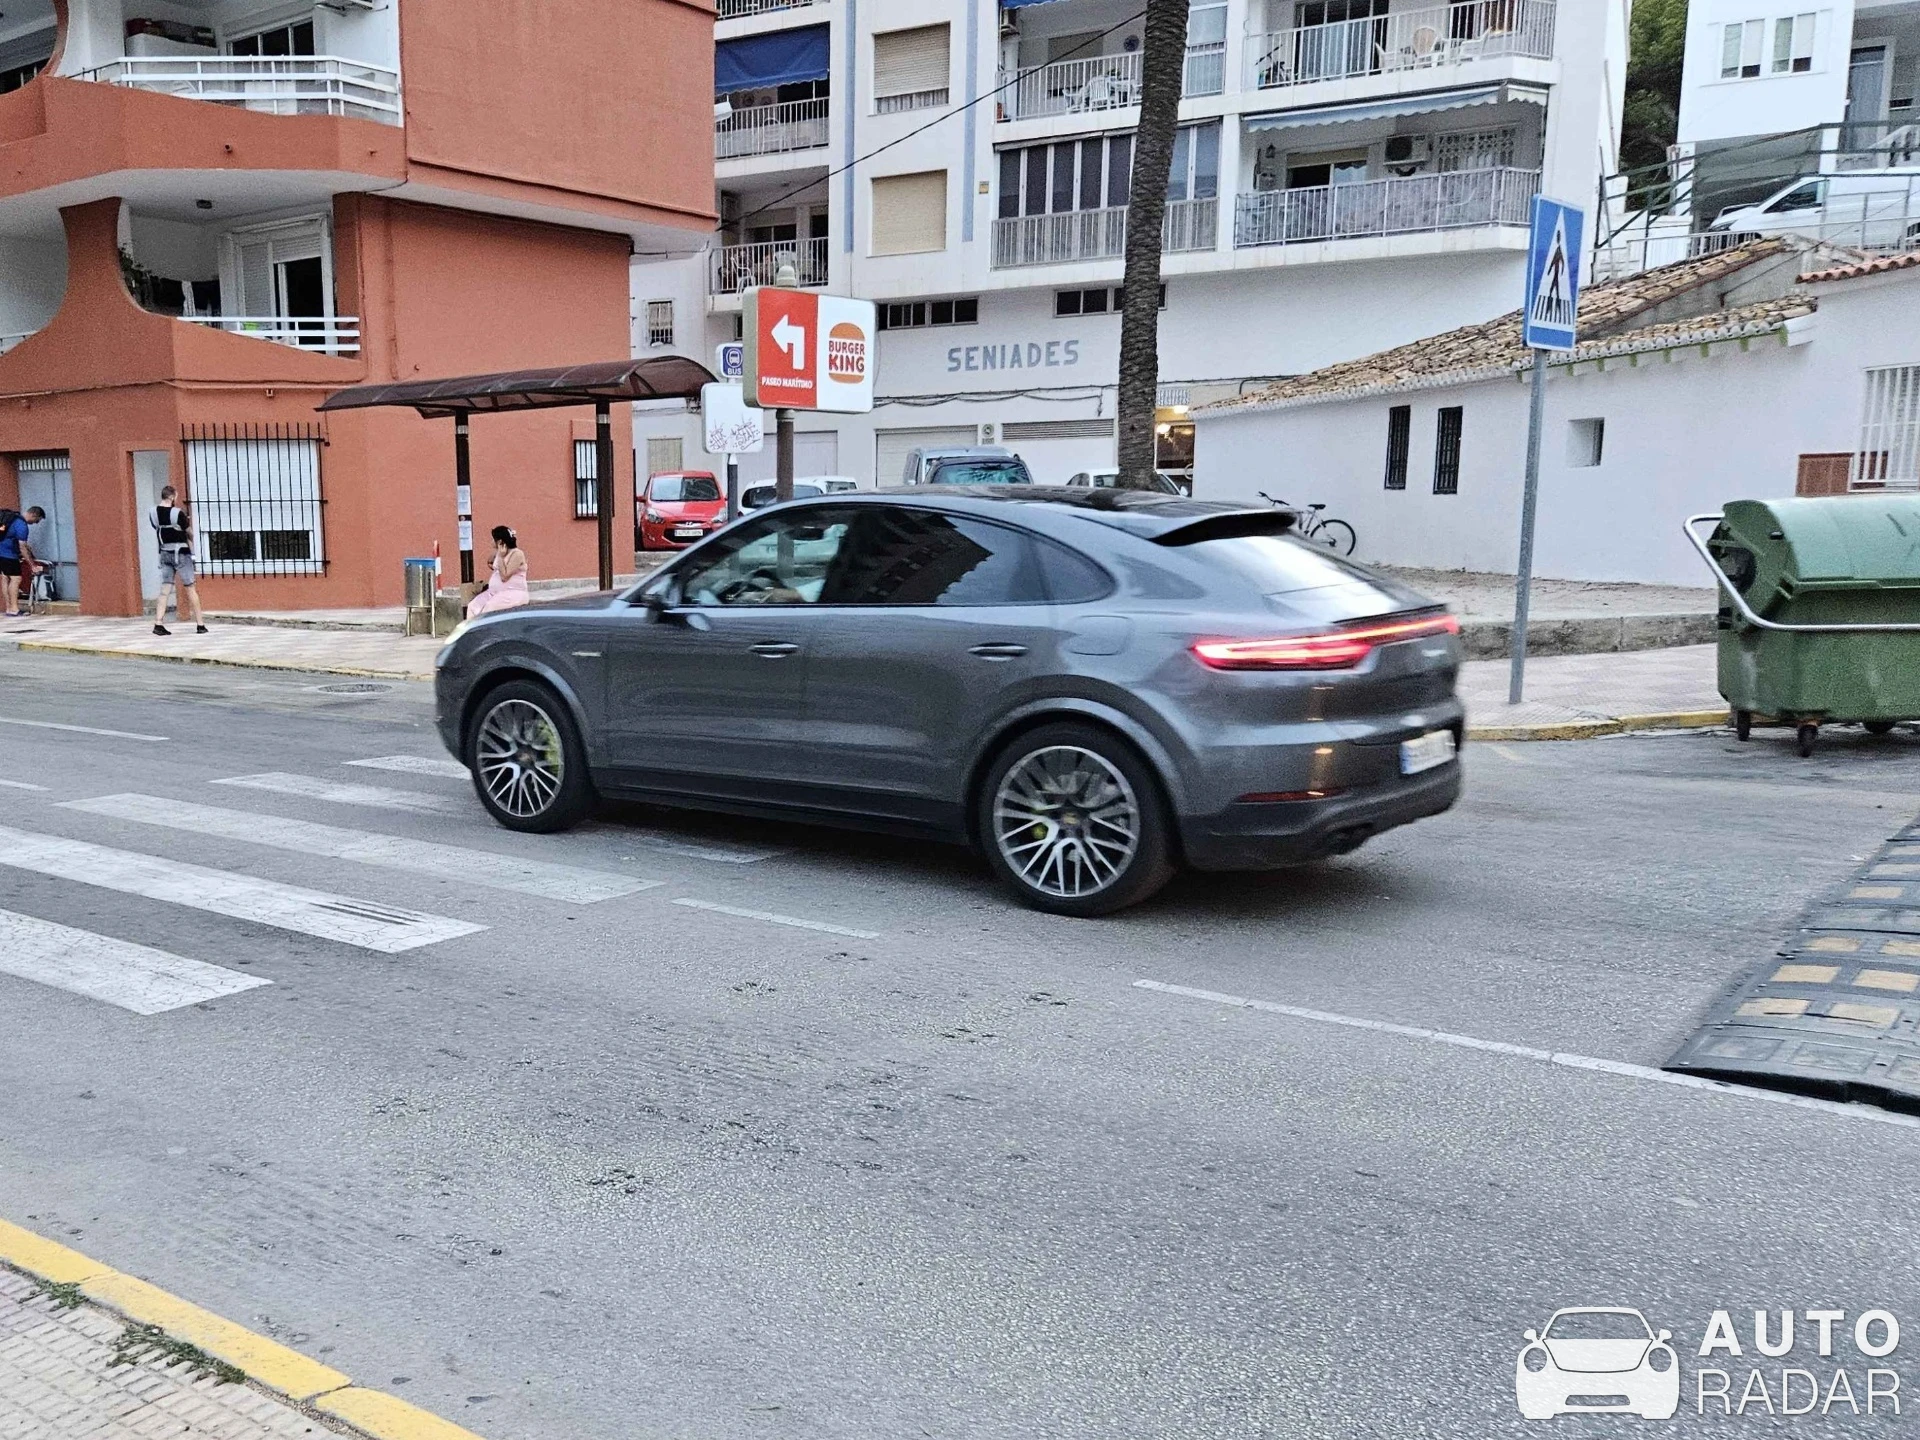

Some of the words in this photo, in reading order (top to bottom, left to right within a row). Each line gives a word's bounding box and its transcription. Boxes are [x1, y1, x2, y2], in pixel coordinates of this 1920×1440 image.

[829, 340, 865, 355] BURGER
[947, 339, 1080, 372] SENIADES
[727, 367, 742, 375] BUS
[829, 354, 865, 373] KING
[762, 376, 782, 387] PASEO
